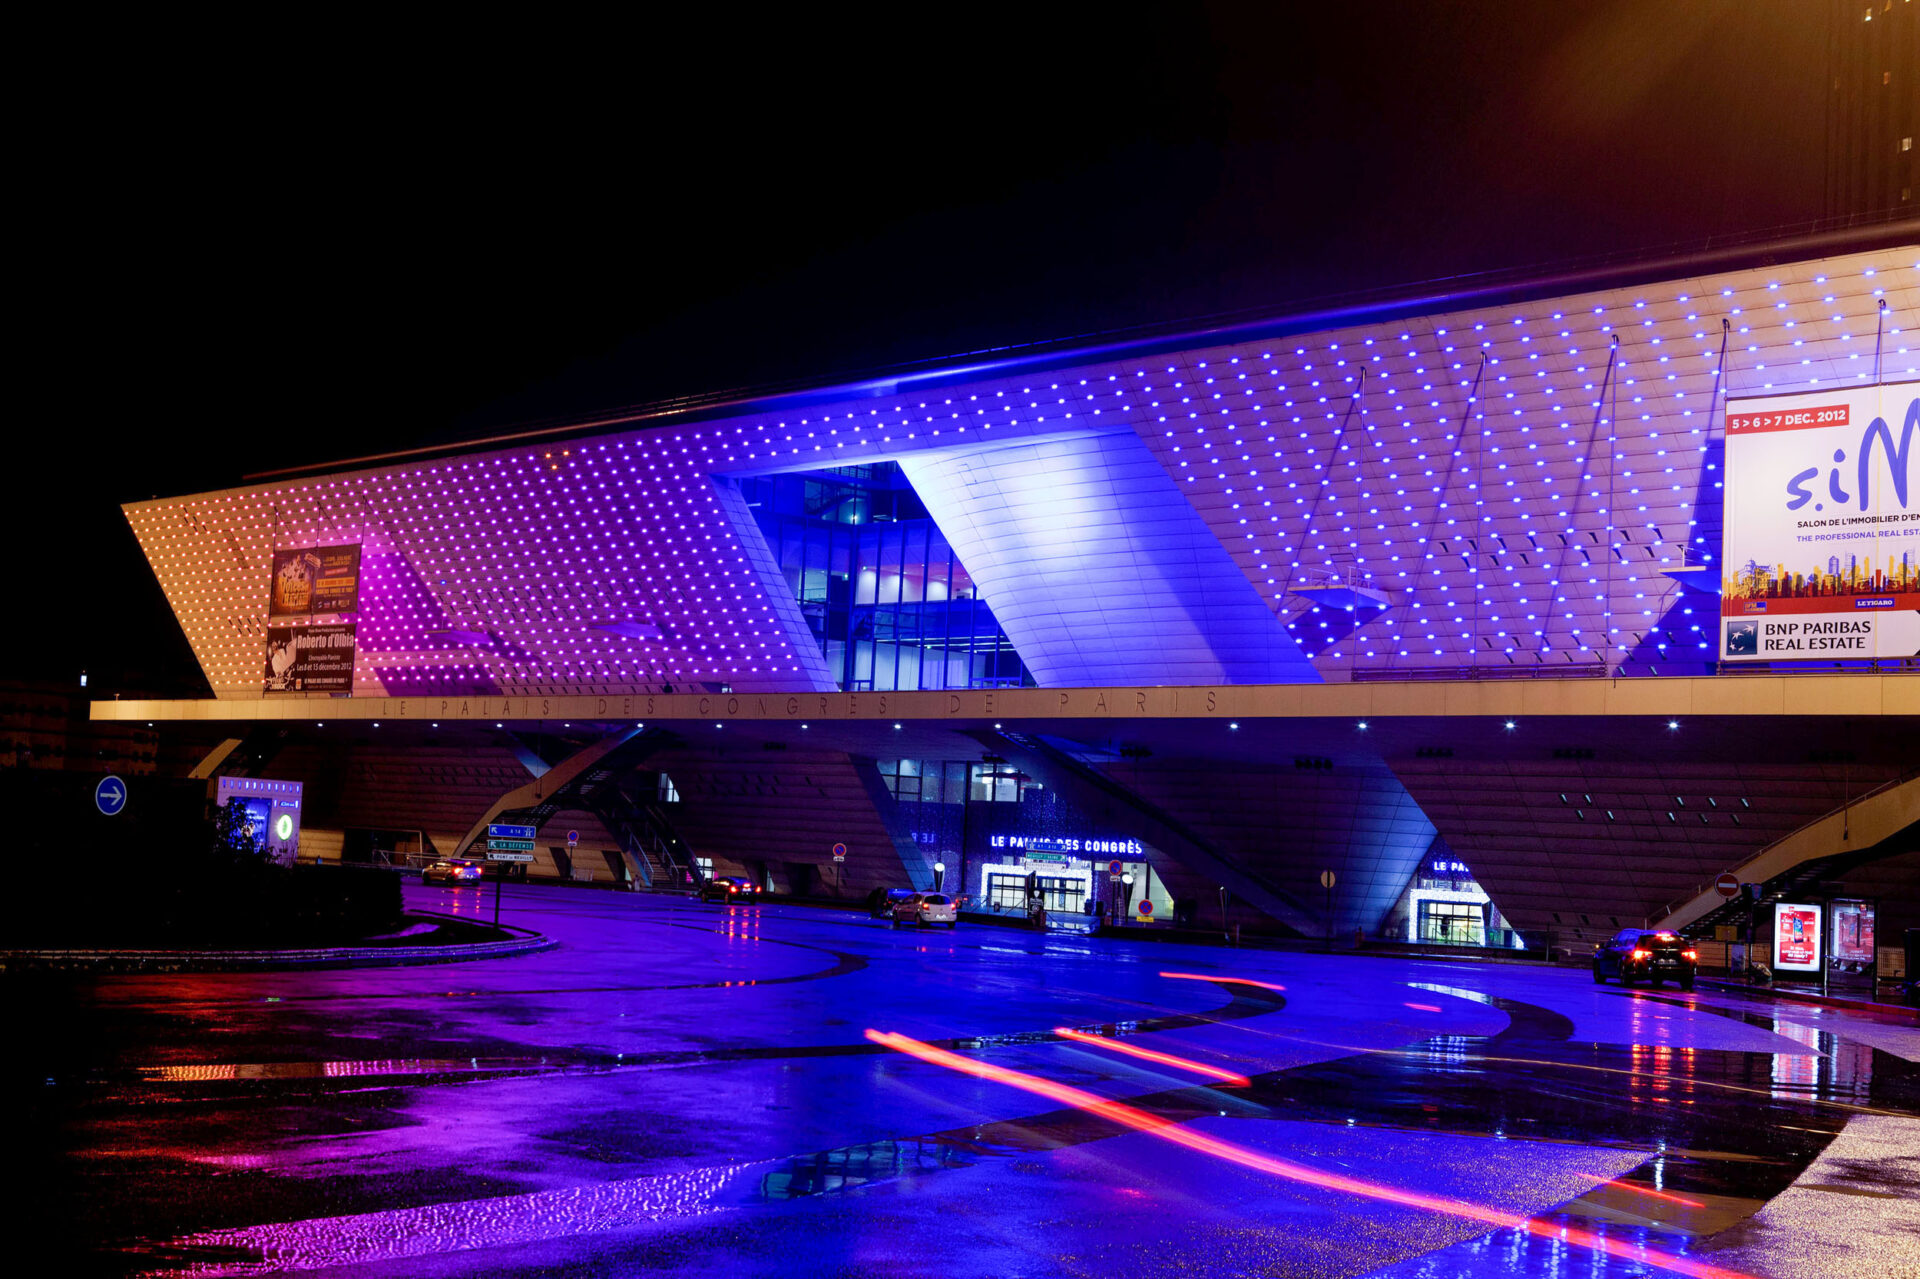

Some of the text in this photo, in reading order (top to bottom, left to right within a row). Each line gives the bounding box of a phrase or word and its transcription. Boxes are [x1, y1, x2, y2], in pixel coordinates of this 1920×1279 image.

[1732, 419, 1740, 429] 5
[1753, 418, 1761, 428] 6
[1774, 416, 1782, 426] 7
[1785, 413, 1814, 425] DEC.
[1816, 410, 1846, 422] 2012
[1797, 519, 1827, 529] SALON
[1829, 518, 1840, 526] DE
[1842, 514, 1900, 526] L'IMMOBILIER
[1815, 531, 1876, 541] PROFESSIONAL
[1878, 530, 1901, 538] REAL
[1903, 528, 1920, 536] EST
[1765, 621, 1871, 636] BNP PARIBAS
[297, 633, 354, 649] Roberto d'Olbia
[1765, 637, 1866, 651] REAL ESTATE
[383, 700, 406, 716] LE
[441, 700, 550, 716] PALAIS
[598, 698, 654, 715] DES
[950, 694, 993, 713] DE
[1060, 691, 1216, 713] PARIS
[991, 836, 1004, 847] LE
[1085, 840, 1143, 854] CONGRÈS
[1434, 862, 1469, 872] LE PA
